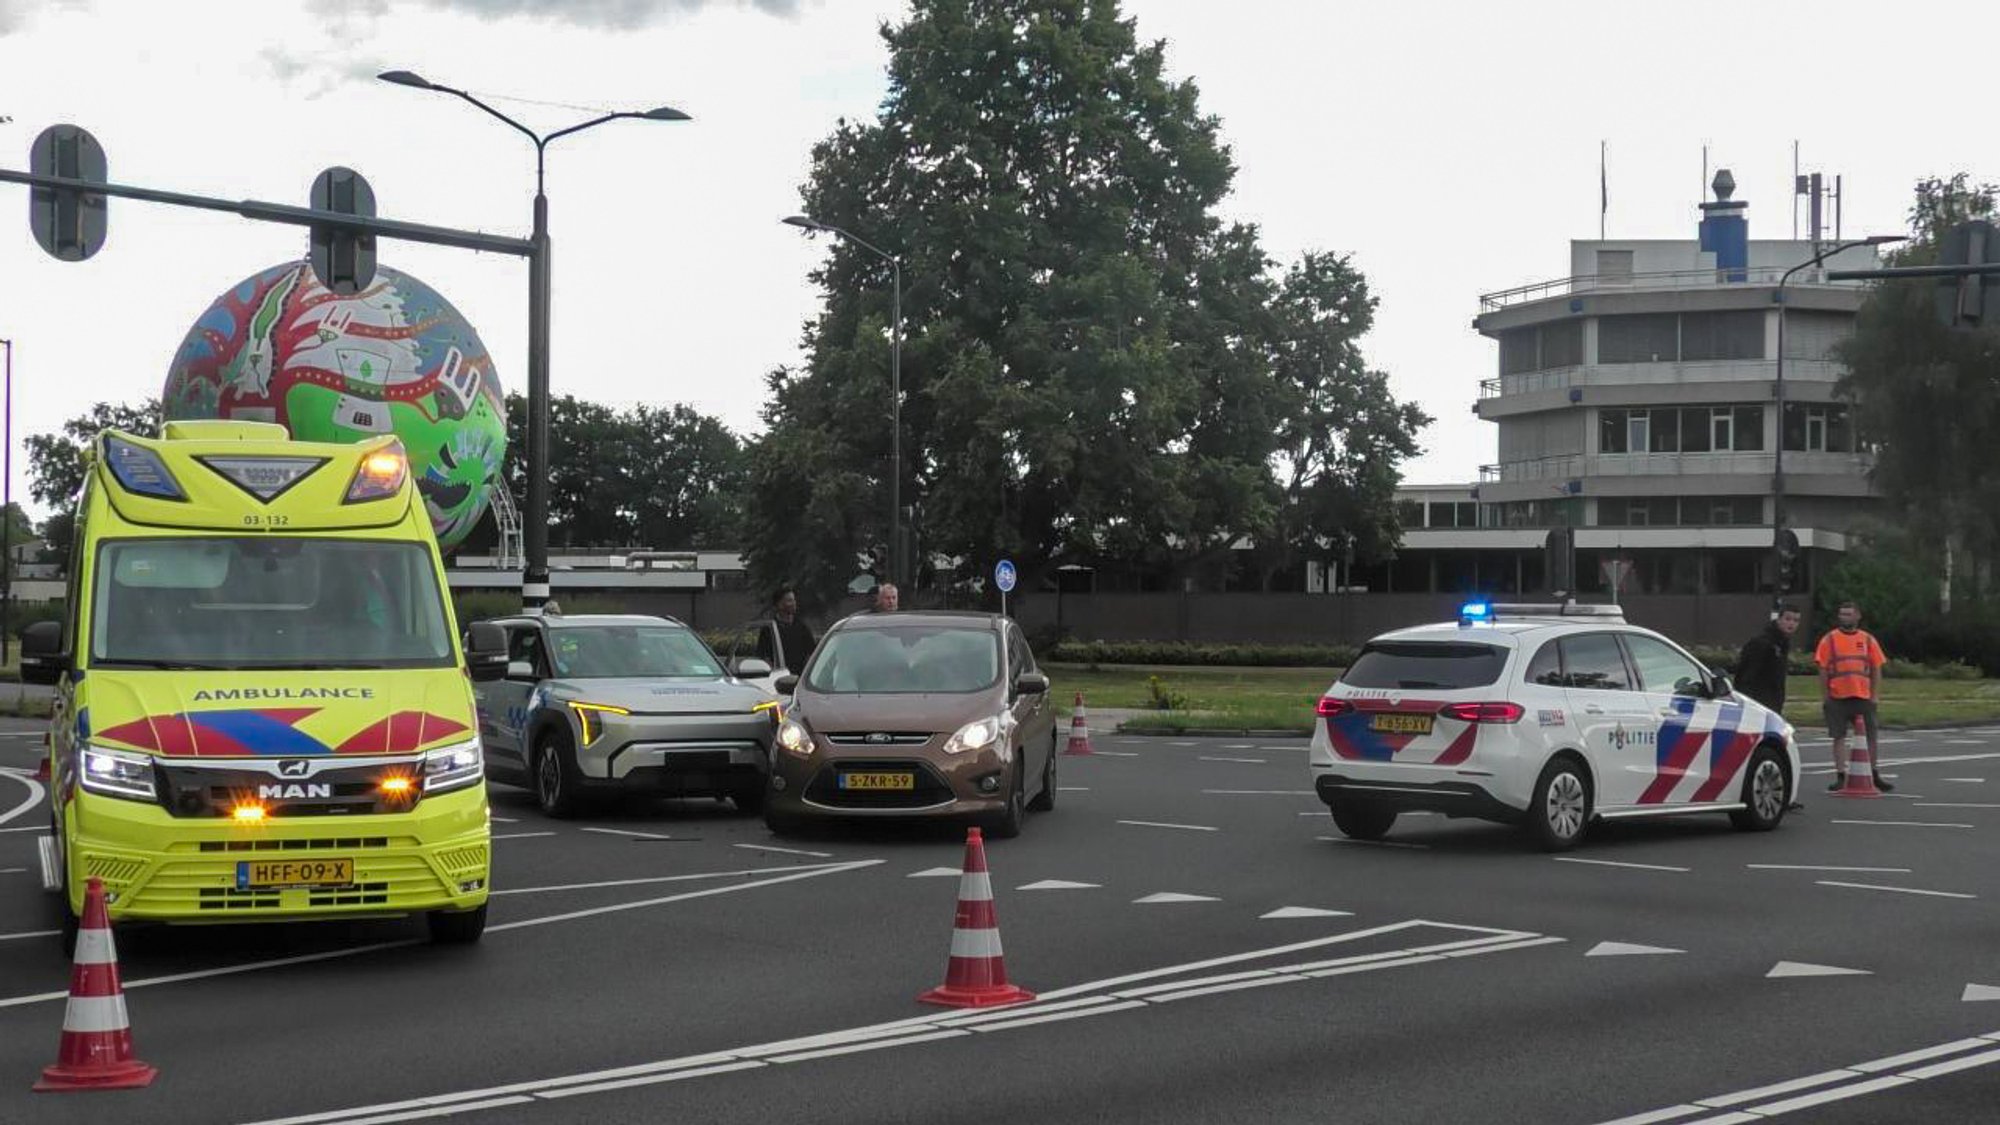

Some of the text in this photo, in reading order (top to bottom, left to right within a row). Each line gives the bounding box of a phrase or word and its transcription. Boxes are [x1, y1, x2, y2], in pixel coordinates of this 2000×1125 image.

[244, 515, 289, 525] 03-132
[194, 688, 375, 701] AMBULANCE
[850, 775, 909, 787] 5-ZKR-59
[259, 784, 330, 798] MAN
[256, 863, 345, 882] HFF-09-X
